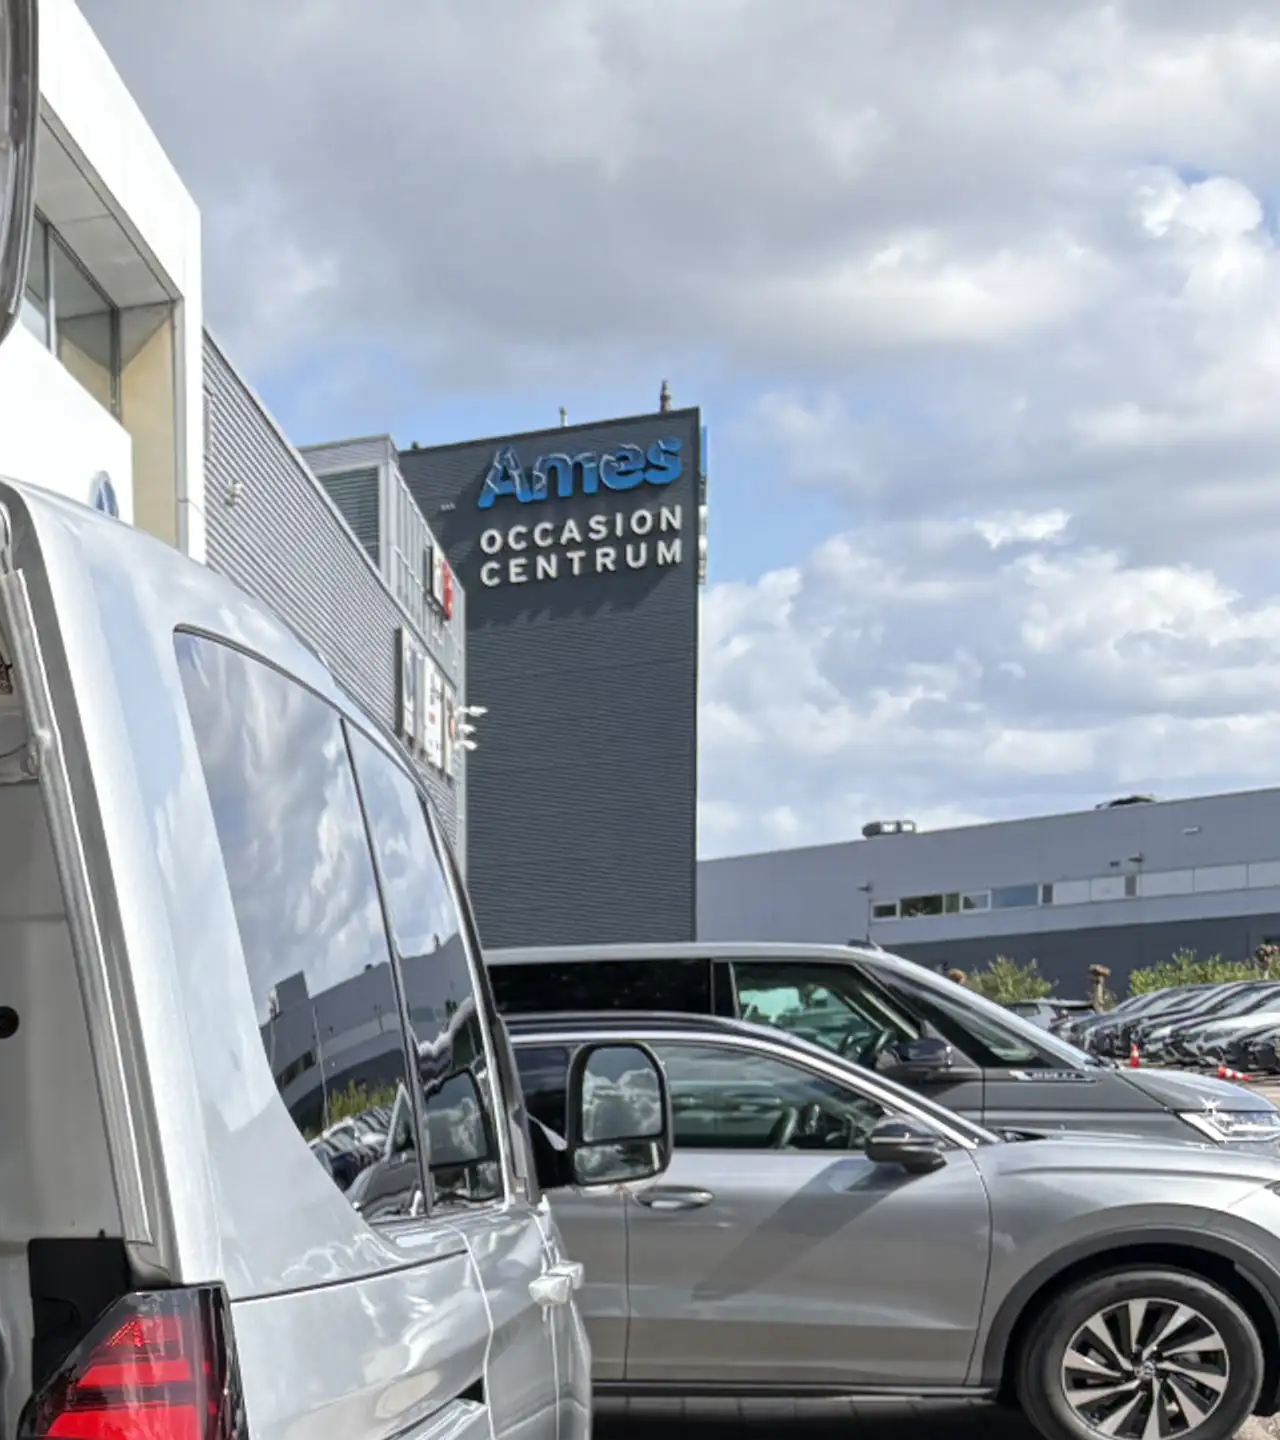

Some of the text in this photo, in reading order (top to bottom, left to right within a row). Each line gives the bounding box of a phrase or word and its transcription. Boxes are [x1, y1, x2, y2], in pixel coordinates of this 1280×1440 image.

[477, 436, 683, 509] Ames
[479, 504, 683, 556] OCCASION
[479, 537, 682, 588] CENTRUM
